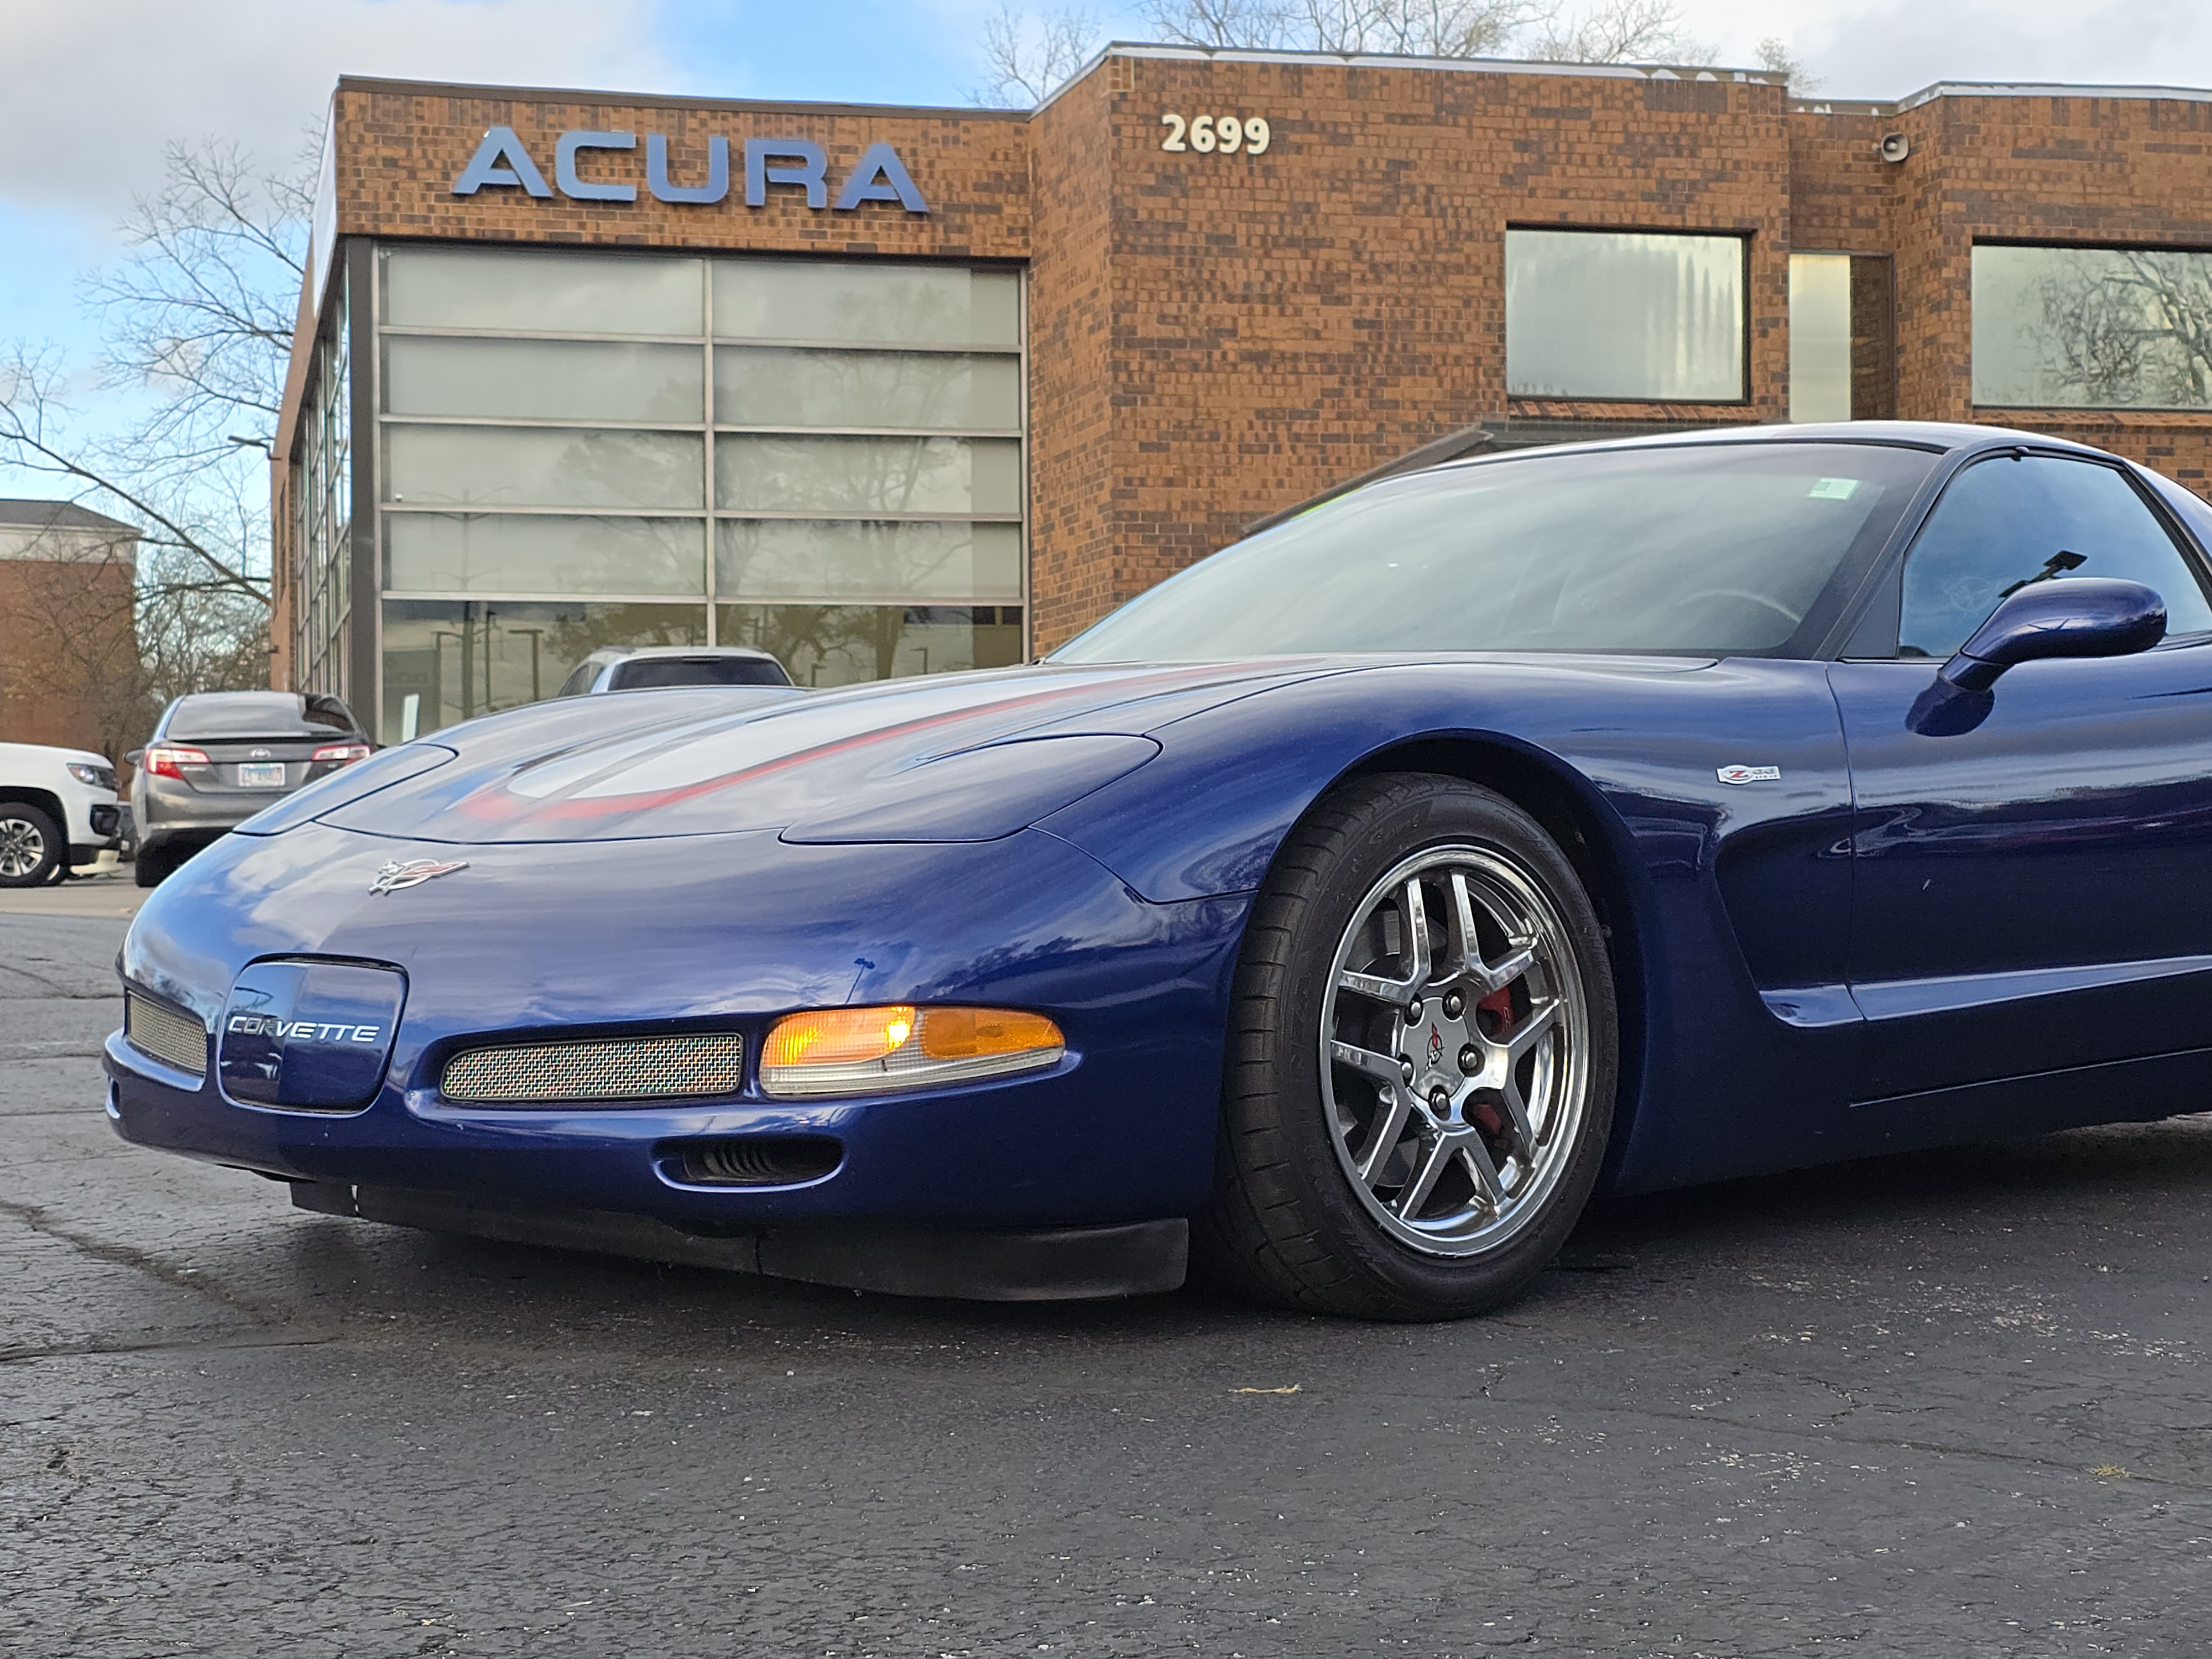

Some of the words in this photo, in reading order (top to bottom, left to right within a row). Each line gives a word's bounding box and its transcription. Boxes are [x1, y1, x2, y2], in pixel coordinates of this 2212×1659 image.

[1162, 114, 1270, 154] 2699
[451, 126, 930, 212] ACURA
[228, 1016, 380, 1042] CORVETTE
